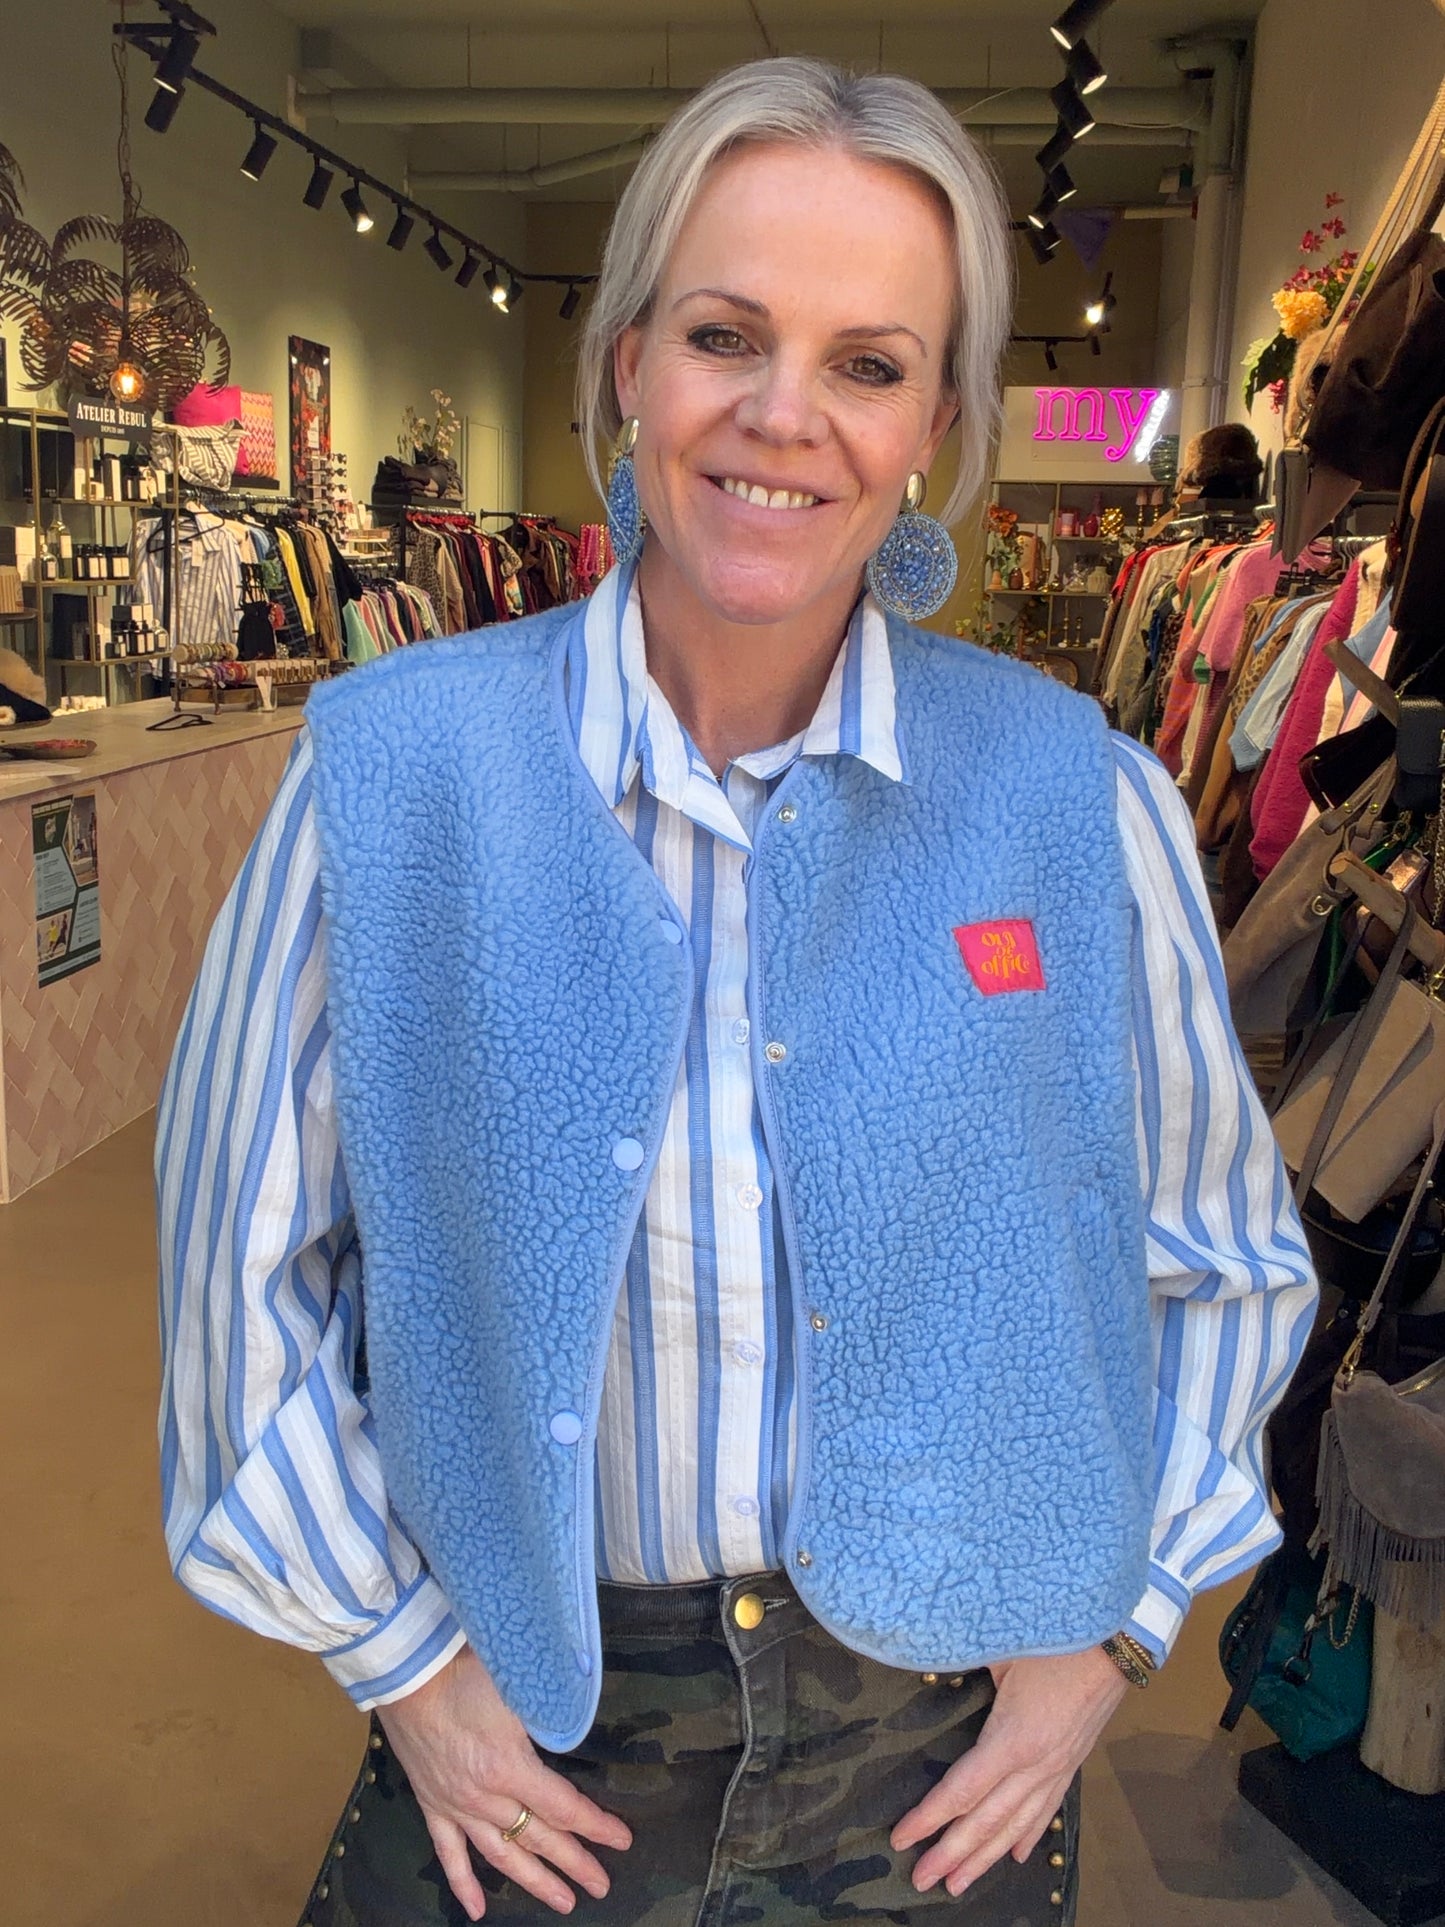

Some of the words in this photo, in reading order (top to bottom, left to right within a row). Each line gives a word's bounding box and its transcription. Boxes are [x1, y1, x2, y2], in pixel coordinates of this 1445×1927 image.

[76, 402, 116, 424] ATELIER
[118, 408, 147, 428] REBUL
[1033, 388, 1158, 463] my
